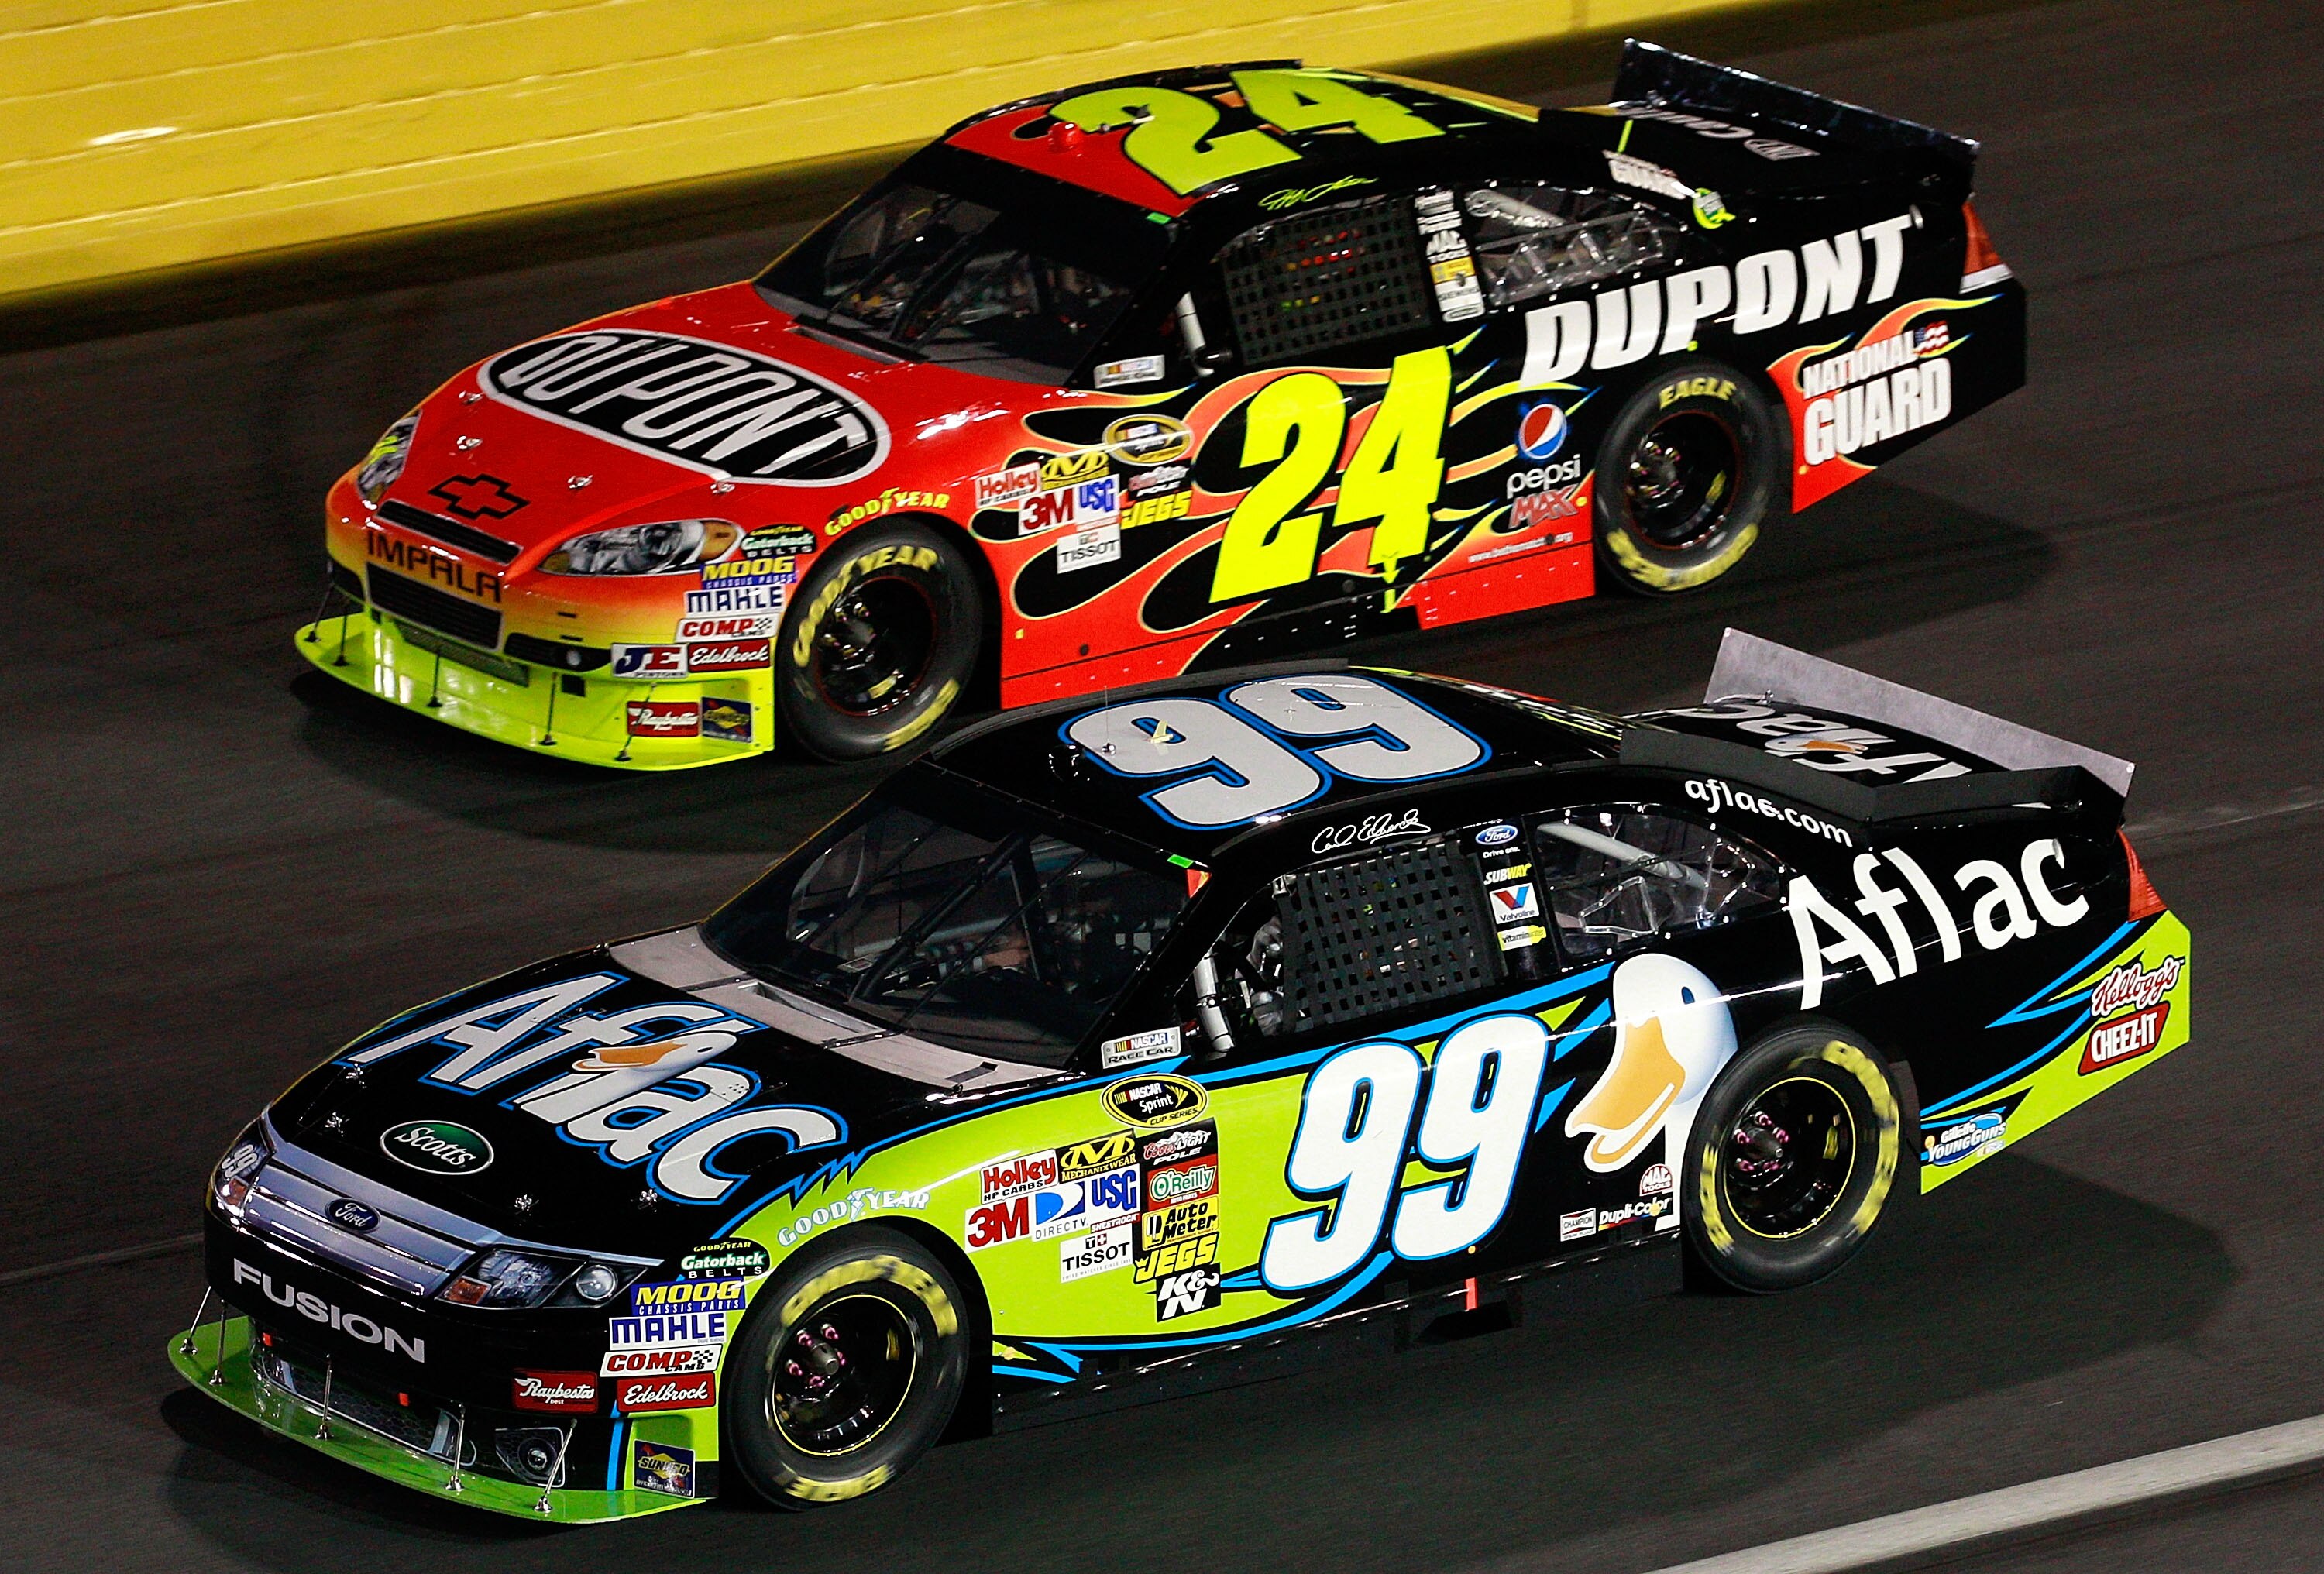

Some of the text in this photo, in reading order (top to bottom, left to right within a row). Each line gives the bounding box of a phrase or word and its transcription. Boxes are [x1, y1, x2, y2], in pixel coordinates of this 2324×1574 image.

[1047, 69, 1446, 196] 24
[1519, 212, 1914, 388] DUPONT
[1803, 330, 1919, 400] NATIONAL
[499, 335, 868, 475] DUPONT
[1659, 377, 1737, 409] EAGLE
[1803, 357, 1951, 465] GUARD
[979, 470, 1037, 500] Holley
[1209, 345, 1451, 603] 24
[1507, 454, 1580, 499] pepsi
[1023, 488, 1074, 530] 3M
[1080, 479, 1114, 512] USG
[1508, 483, 1580, 529] MAX
[1120, 490, 1193, 530] JEGS
[1060, 539, 1118, 563] TISSOT
[367, 531, 500, 603] IMPALA
[705, 556, 795, 580] MOOG
[688, 586, 782, 613] MAHLE
[683, 618, 754, 637] COMP
[616, 647, 681, 673] JE
[689, 645, 768, 665] Edelbrock
[1063, 673, 1487, 827] 99
[1684, 778, 1853, 848] aflac.com
[1484, 828, 1511, 843] Ford
[1483, 847, 1504, 858] Drive
[1483, 862, 1532, 885] SUBWAY
[1499, 909, 1536, 922] Valvoline
[1789, 838, 2090, 1010] Aflac
[2092, 957, 2181, 1016] Kellogg's
[1130, 1033, 1167, 1050] NASCAR
[2092, 1012, 2158, 1062] CHEEZ-IT
[1108, 1046, 1173, 1064] RACE CAR
[1129, 1083, 1163, 1101] NASCAR
[1139, 1093, 1174, 1114] Sprint
[1150, 1108, 1198, 1126] CUP SERIES
[395, 1127, 478, 1167] Scotts
[1153, 1146, 1202, 1166] POLE
[1262, 1012, 1549, 1290] 99
[983, 1157, 1056, 1194] Holley
[1061, 1154, 1136, 1183] MECHANIX WEAR
[1642, 1166, 1672, 1187] MAC
[984, 1180, 1043, 1201] HP CARBS
[1092, 1170, 1137, 1211] USG
[1153, 1169, 1212, 1197] O'Reilly
[335, 1201, 373, 1229] Ford
[778, 1187, 930, 1247] GOODYEAR
[968, 1196, 1030, 1248] 3M
[1091, 1213, 1138, 1232] SHEETROCK
[1165, 1201, 1208, 1225] Auto
[1563, 1216, 1593, 1229] CHAMPION
[1599, 1197, 1672, 1224] Dupli-Color
[1036, 1217, 1087, 1239] DIRECTV
[1162, 1214, 1217, 1242] Meter
[693, 1242, 751, 1252] GOODYEAR
[1063, 1242, 1130, 1271] TISSOT
[1135, 1234, 1218, 1283] JEGS
[681, 1252, 765, 1270] Gatorback
[689, 1266, 763, 1279] BELTS
[636, 1280, 742, 1305] MOOG
[233, 1257, 425, 1363] FUSION
[639, 1299, 739, 1315] CHASSIS PARTS
[612, 1313, 724, 1344] MAHLE
[607, 1351, 692, 1372] COMP
[665, 1363, 705, 1372] CAMS
[515, 1378, 595, 1403] Raybestos
[624, 1380, 708, 1405] Edelbrock
[639, 1456, 689, 1475] SUNCO
